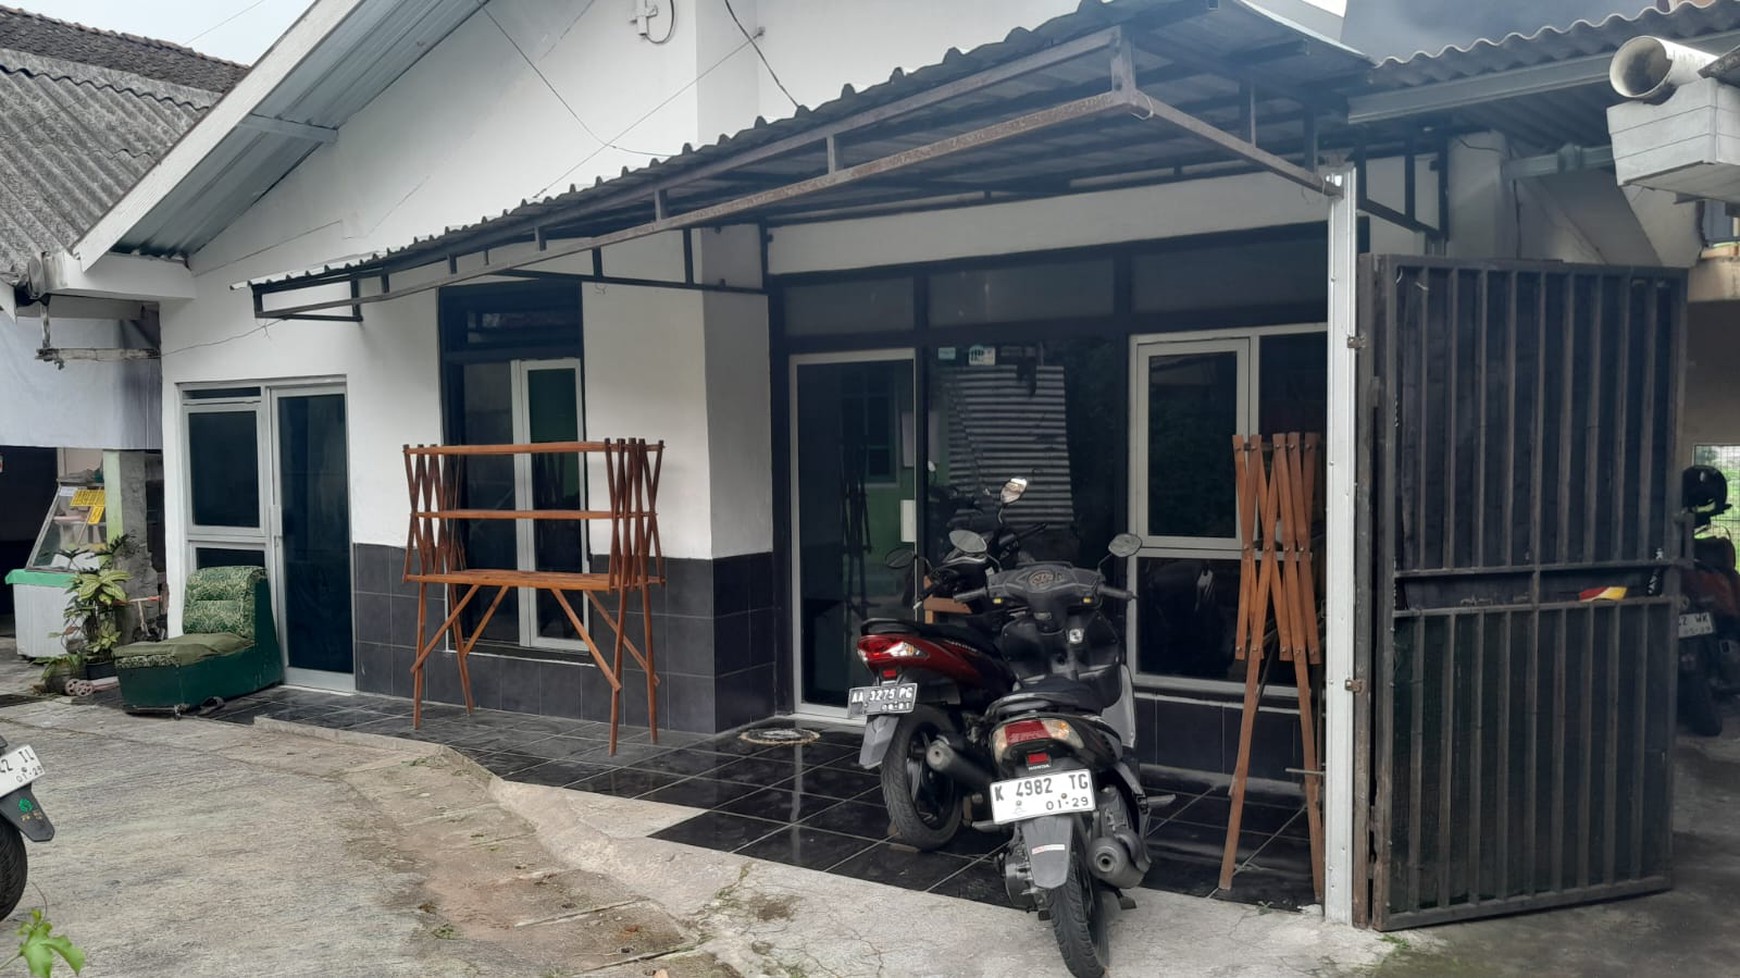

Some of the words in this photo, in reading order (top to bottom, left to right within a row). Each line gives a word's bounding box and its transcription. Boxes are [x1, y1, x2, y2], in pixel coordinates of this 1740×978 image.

[851, 692, 864, 703] AA
[869, 688, 896, 701] 3275
[899, 687, 913, 699] PG
[994, 785, 1005, 801] K
[1016, 777, 1053, 798] 4982
[1068, 774, 1089, 789] TG
